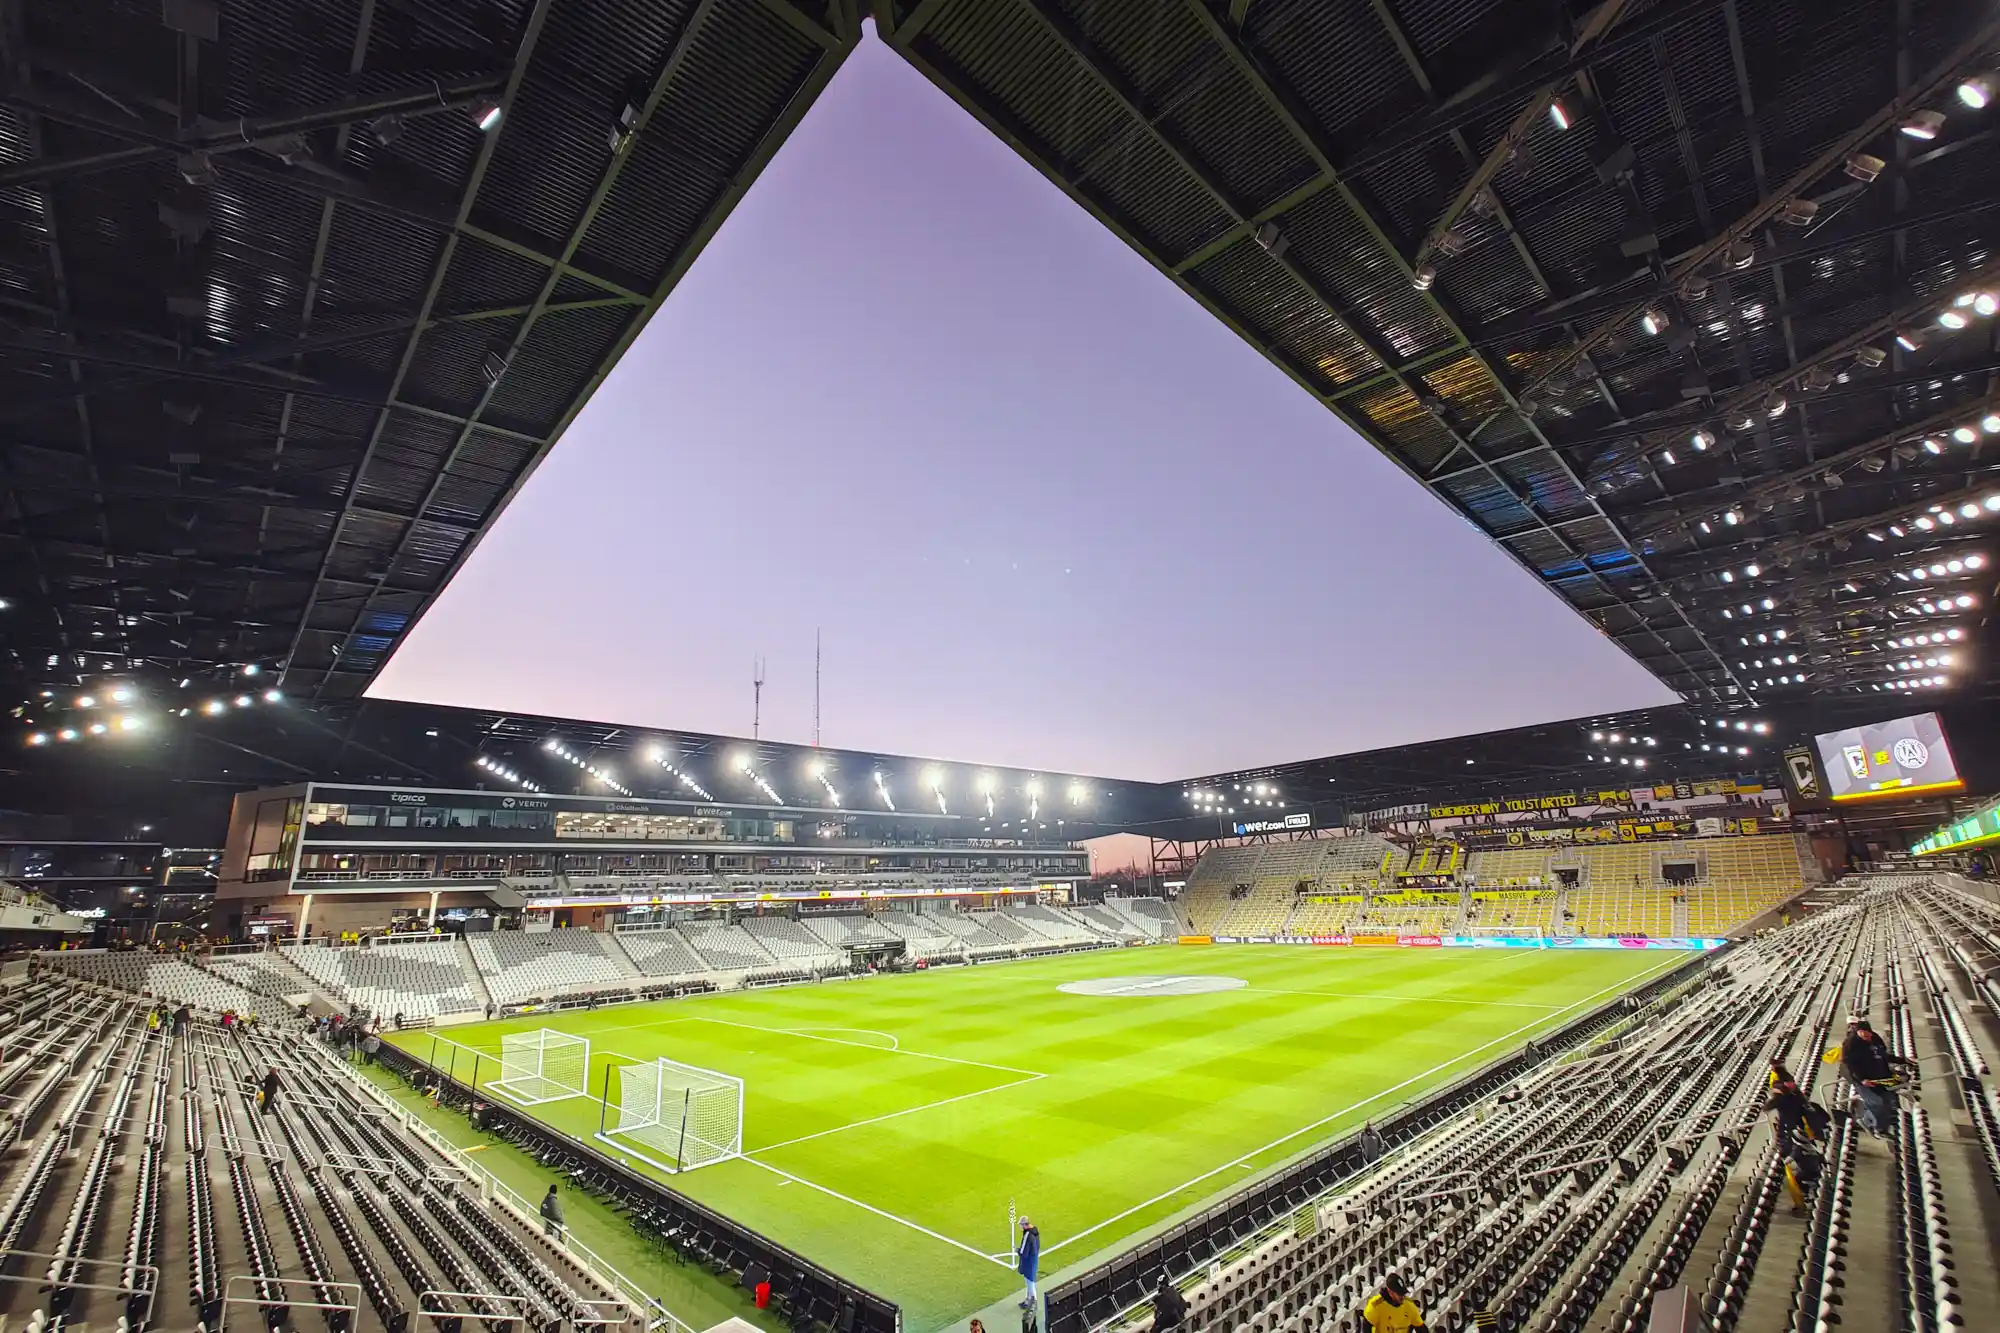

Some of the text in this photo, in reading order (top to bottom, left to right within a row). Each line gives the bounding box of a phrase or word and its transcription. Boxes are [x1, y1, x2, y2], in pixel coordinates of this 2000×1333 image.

[391, 792, 426, 803] tipico
[1505, 799, 1526, 811] YOU
[1526, 795, 1576, 809] STARTED
[518, 800, 549, 808] VERTIV
[1232, 821, 1285, 835] lower.com
